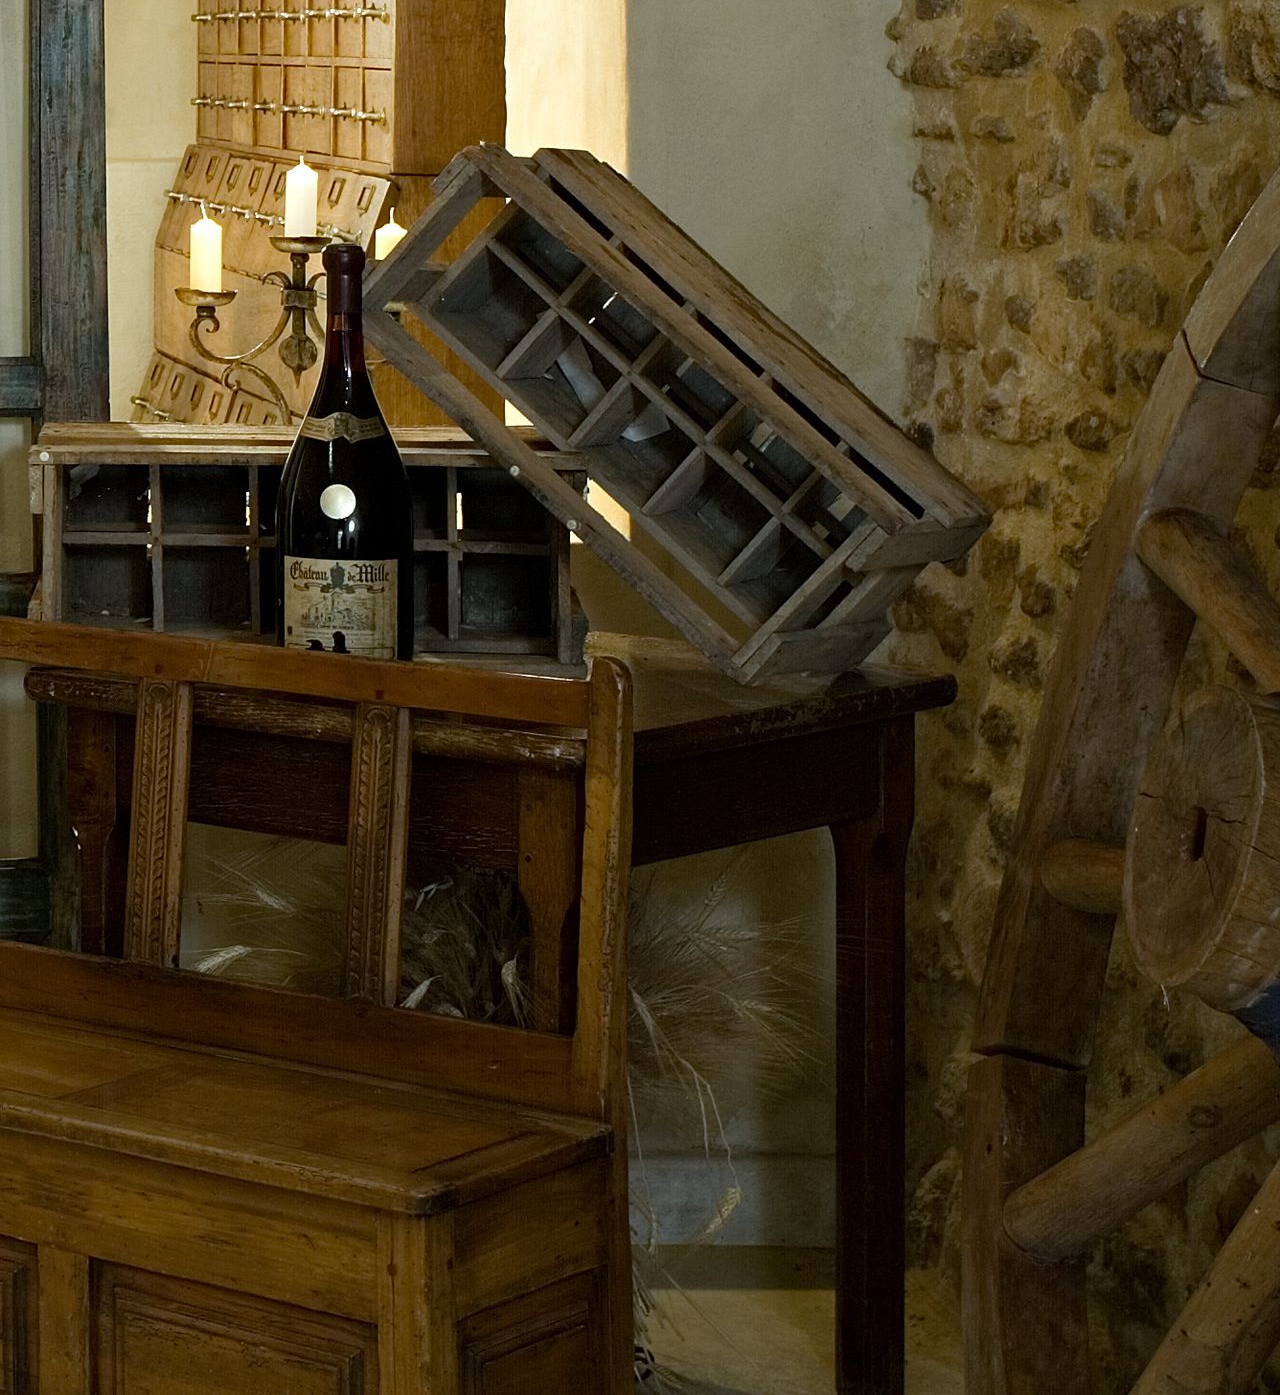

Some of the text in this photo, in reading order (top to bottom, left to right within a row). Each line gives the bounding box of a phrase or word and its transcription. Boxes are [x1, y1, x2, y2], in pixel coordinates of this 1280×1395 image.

[290, 560, 390, 583] Château de Mille
